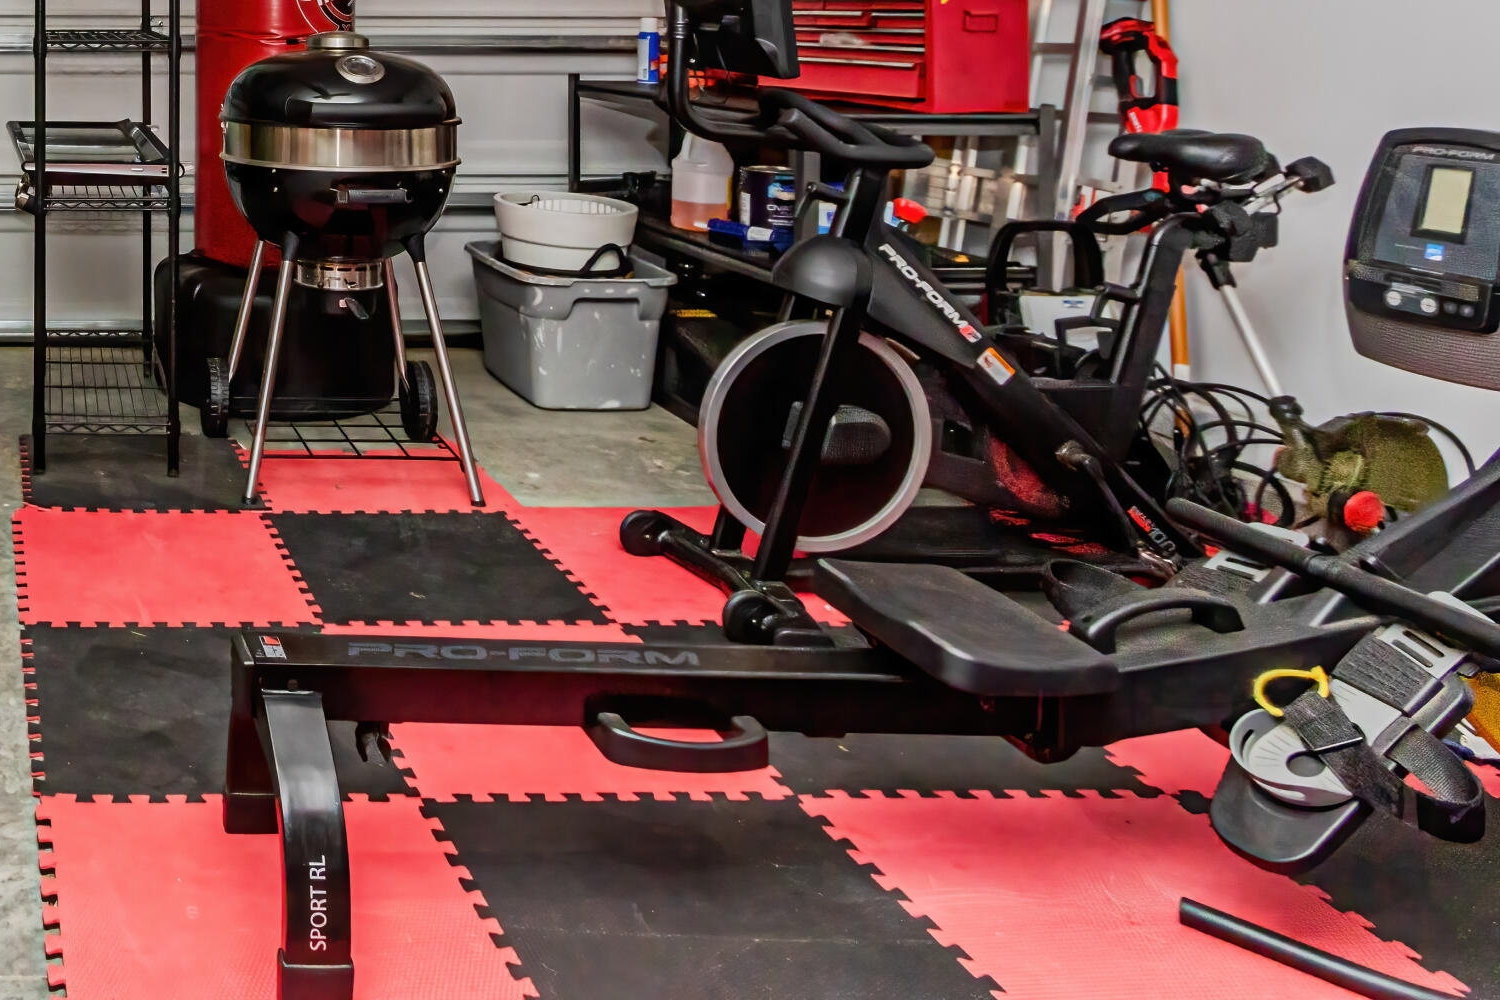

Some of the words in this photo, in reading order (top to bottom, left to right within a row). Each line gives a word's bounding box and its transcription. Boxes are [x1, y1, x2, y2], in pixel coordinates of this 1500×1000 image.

[1411, 145, 1496, 160] PRO-FORM
[878, 243, 970, 329] PRO-FORM
[347, 641, 700, 667] PRO-FORM
[308, 854, 327, 880] RL
[309, 884, 328, 952] SPORT
